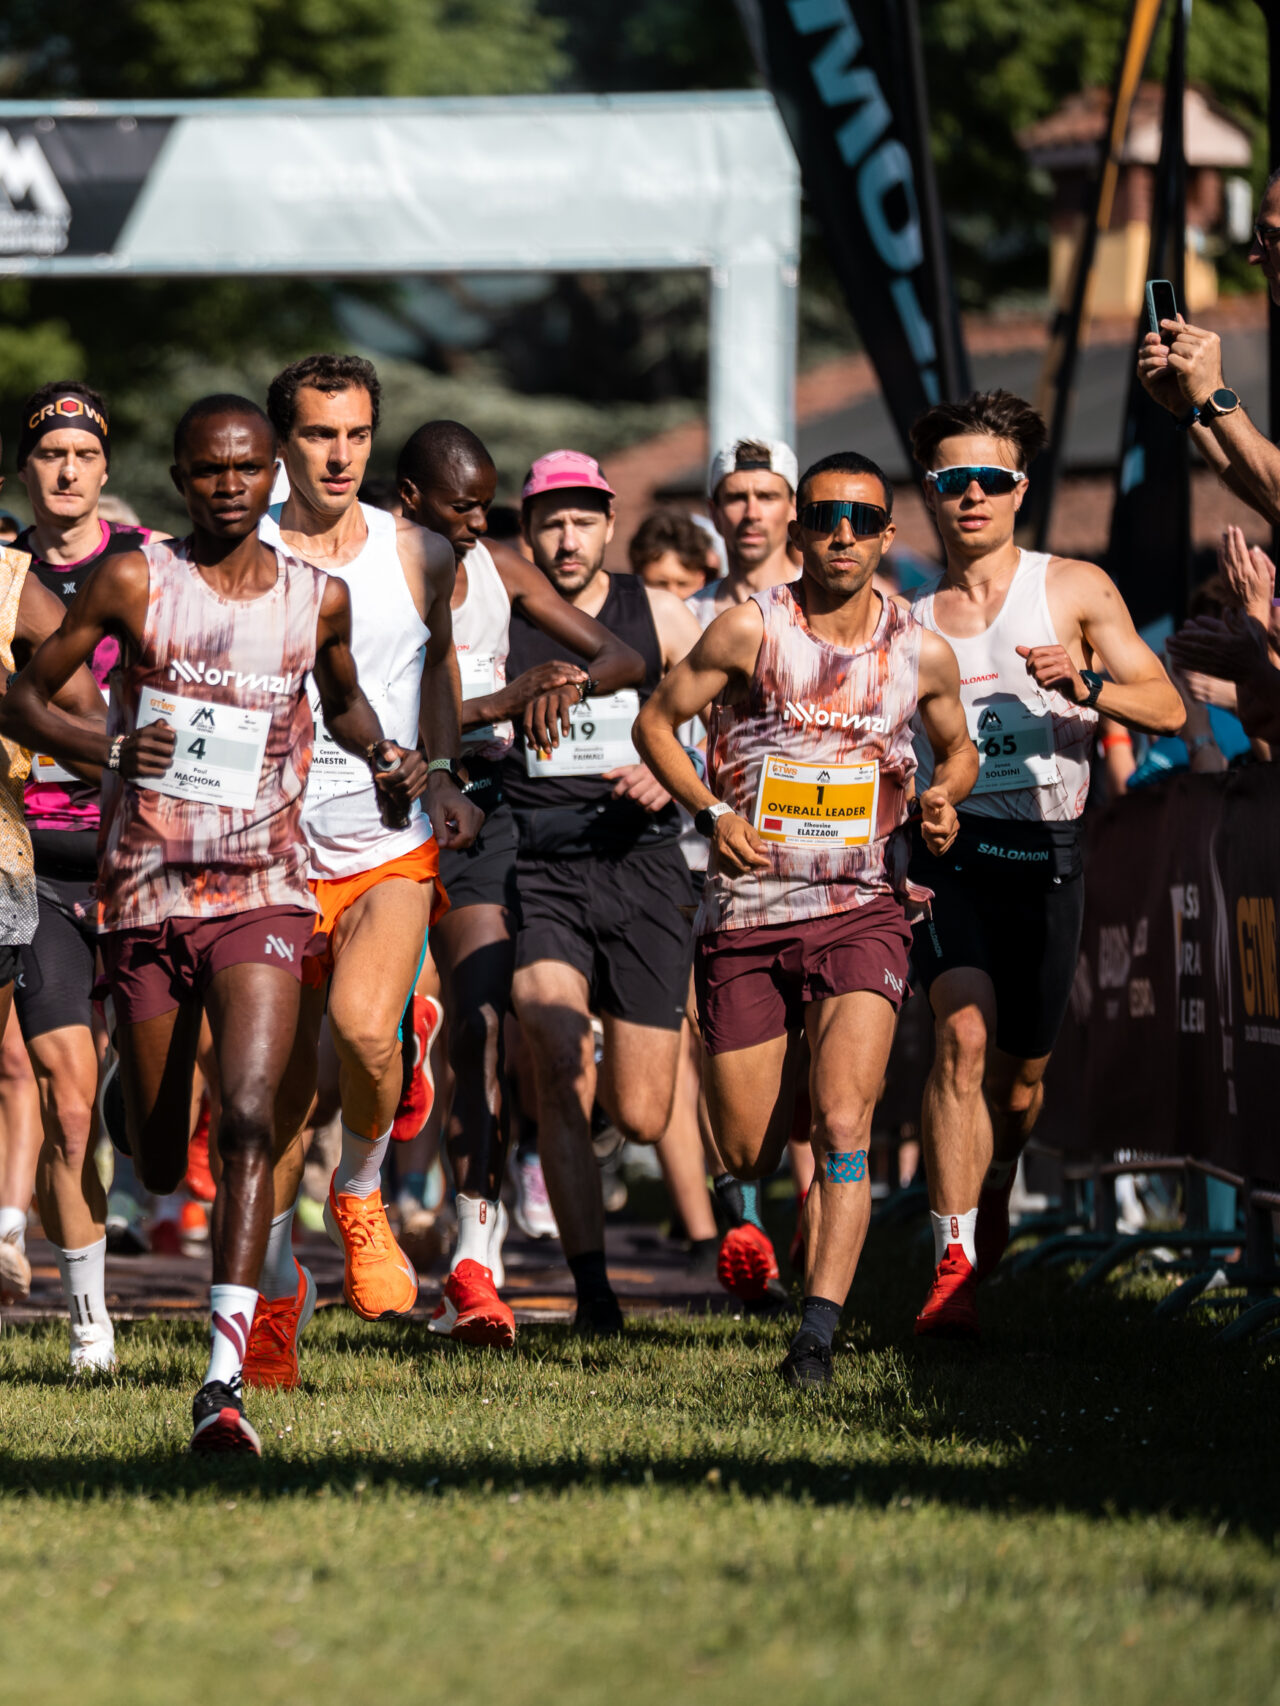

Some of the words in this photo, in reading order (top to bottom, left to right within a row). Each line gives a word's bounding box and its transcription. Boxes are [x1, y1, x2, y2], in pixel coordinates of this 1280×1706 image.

[28, 396, 108, 436] CROWN
[169, 659, 293, 694] Normal
[960, 672, 999, 686] ALOMON
[150, 698, 176, 712] GTWS
[783, 700, 892, 734] Normal
[187, 737, 206, 760] 4
[311, 757, 347, 765] MAESTRI
[772, 764, 798, 776] GTWS
[985, 768, 1020, 779] SOLDINI
[174, 771, 221, 787] MACHOKA
[816, 785, 825, 805] 1
[768, 802, 822, 817] OVERALL
[825, 806, 866, 817] LEADER
[797, 828, 839, 837] ELAZZAOUI
[977, 843, 1049, 861] SALOMON
